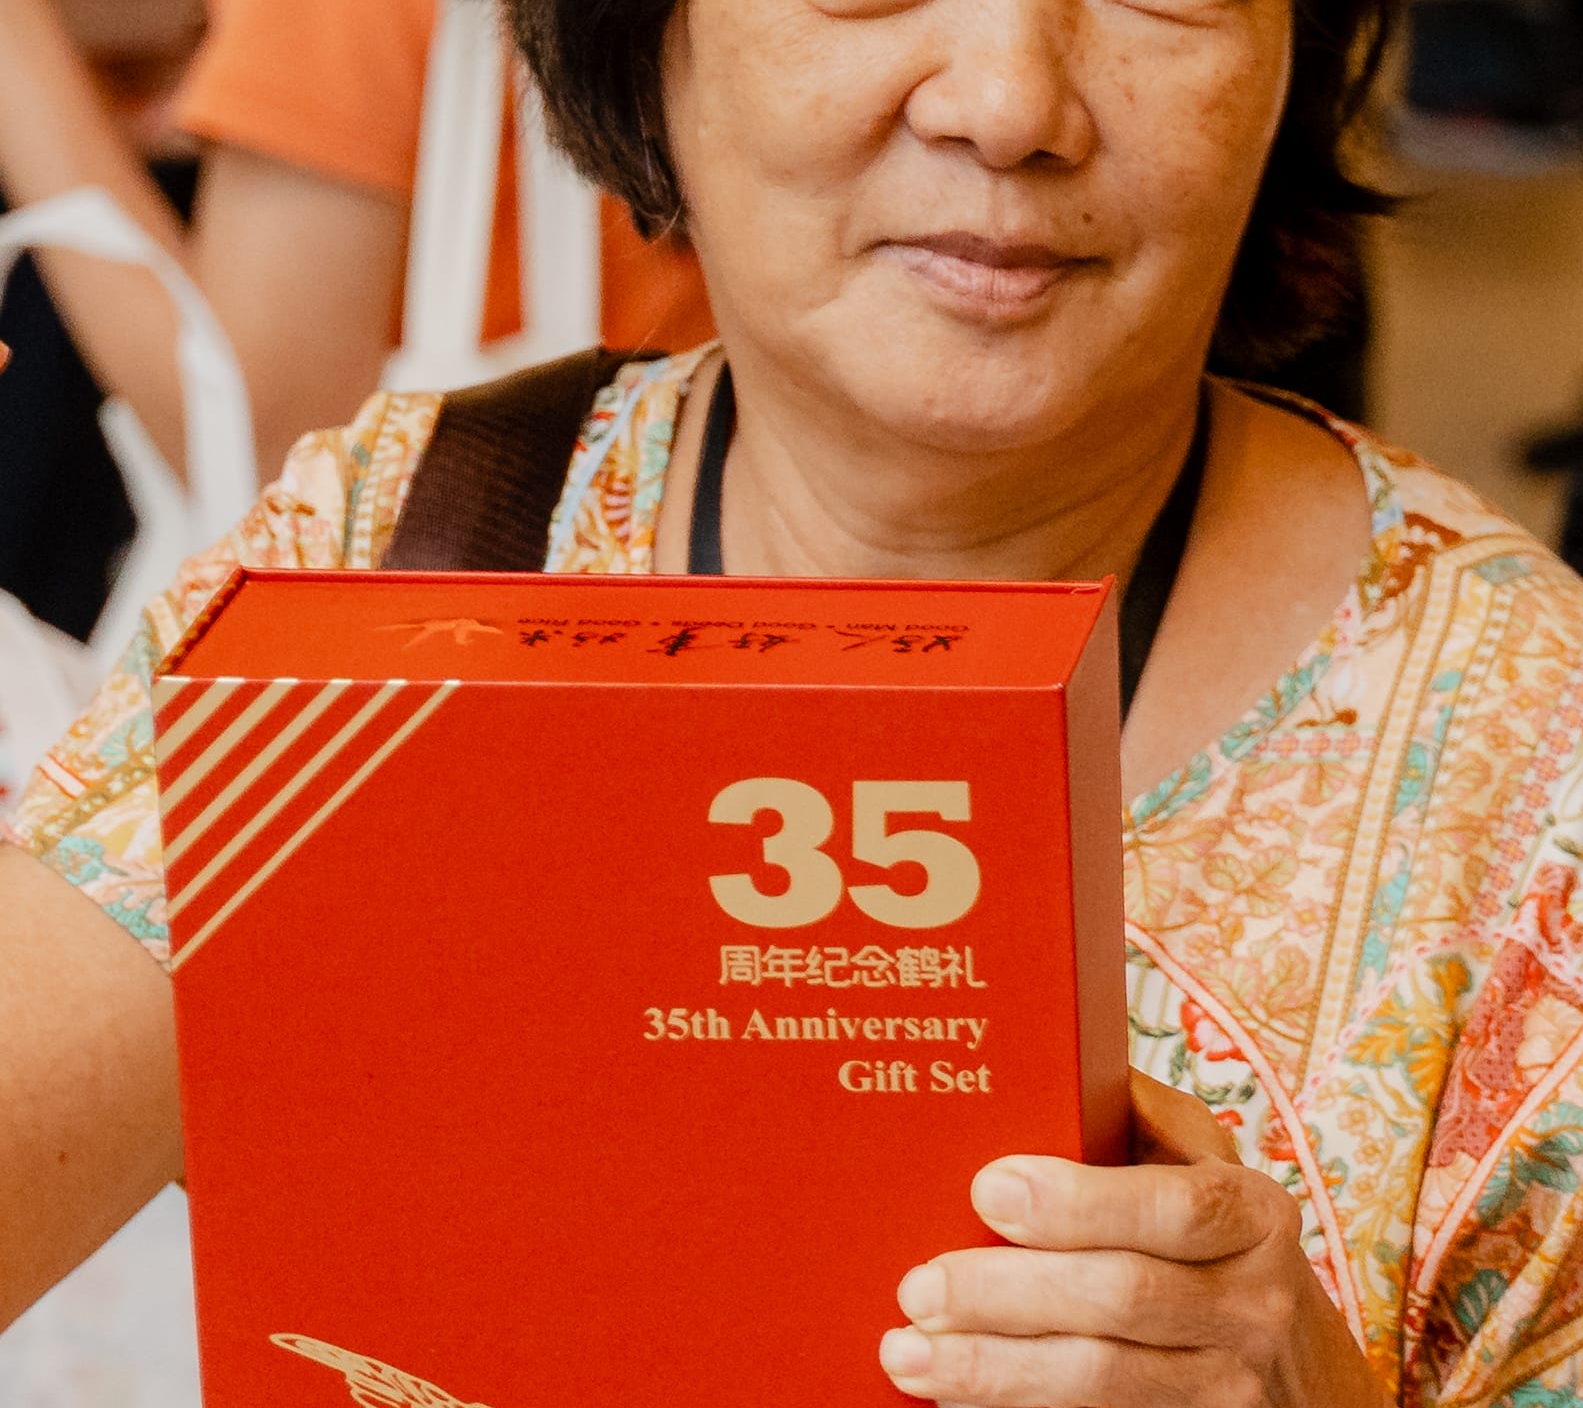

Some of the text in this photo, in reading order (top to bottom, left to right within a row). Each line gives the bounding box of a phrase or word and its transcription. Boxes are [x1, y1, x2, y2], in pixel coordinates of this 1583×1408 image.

[707, 776, 982, 929] 35
[718, 943, 989, 990] 周年纪念鹤礼
[642, 1006, 989, 1050] 35th Anniversary
[837, 1059, 993, 1094] Gift Set
